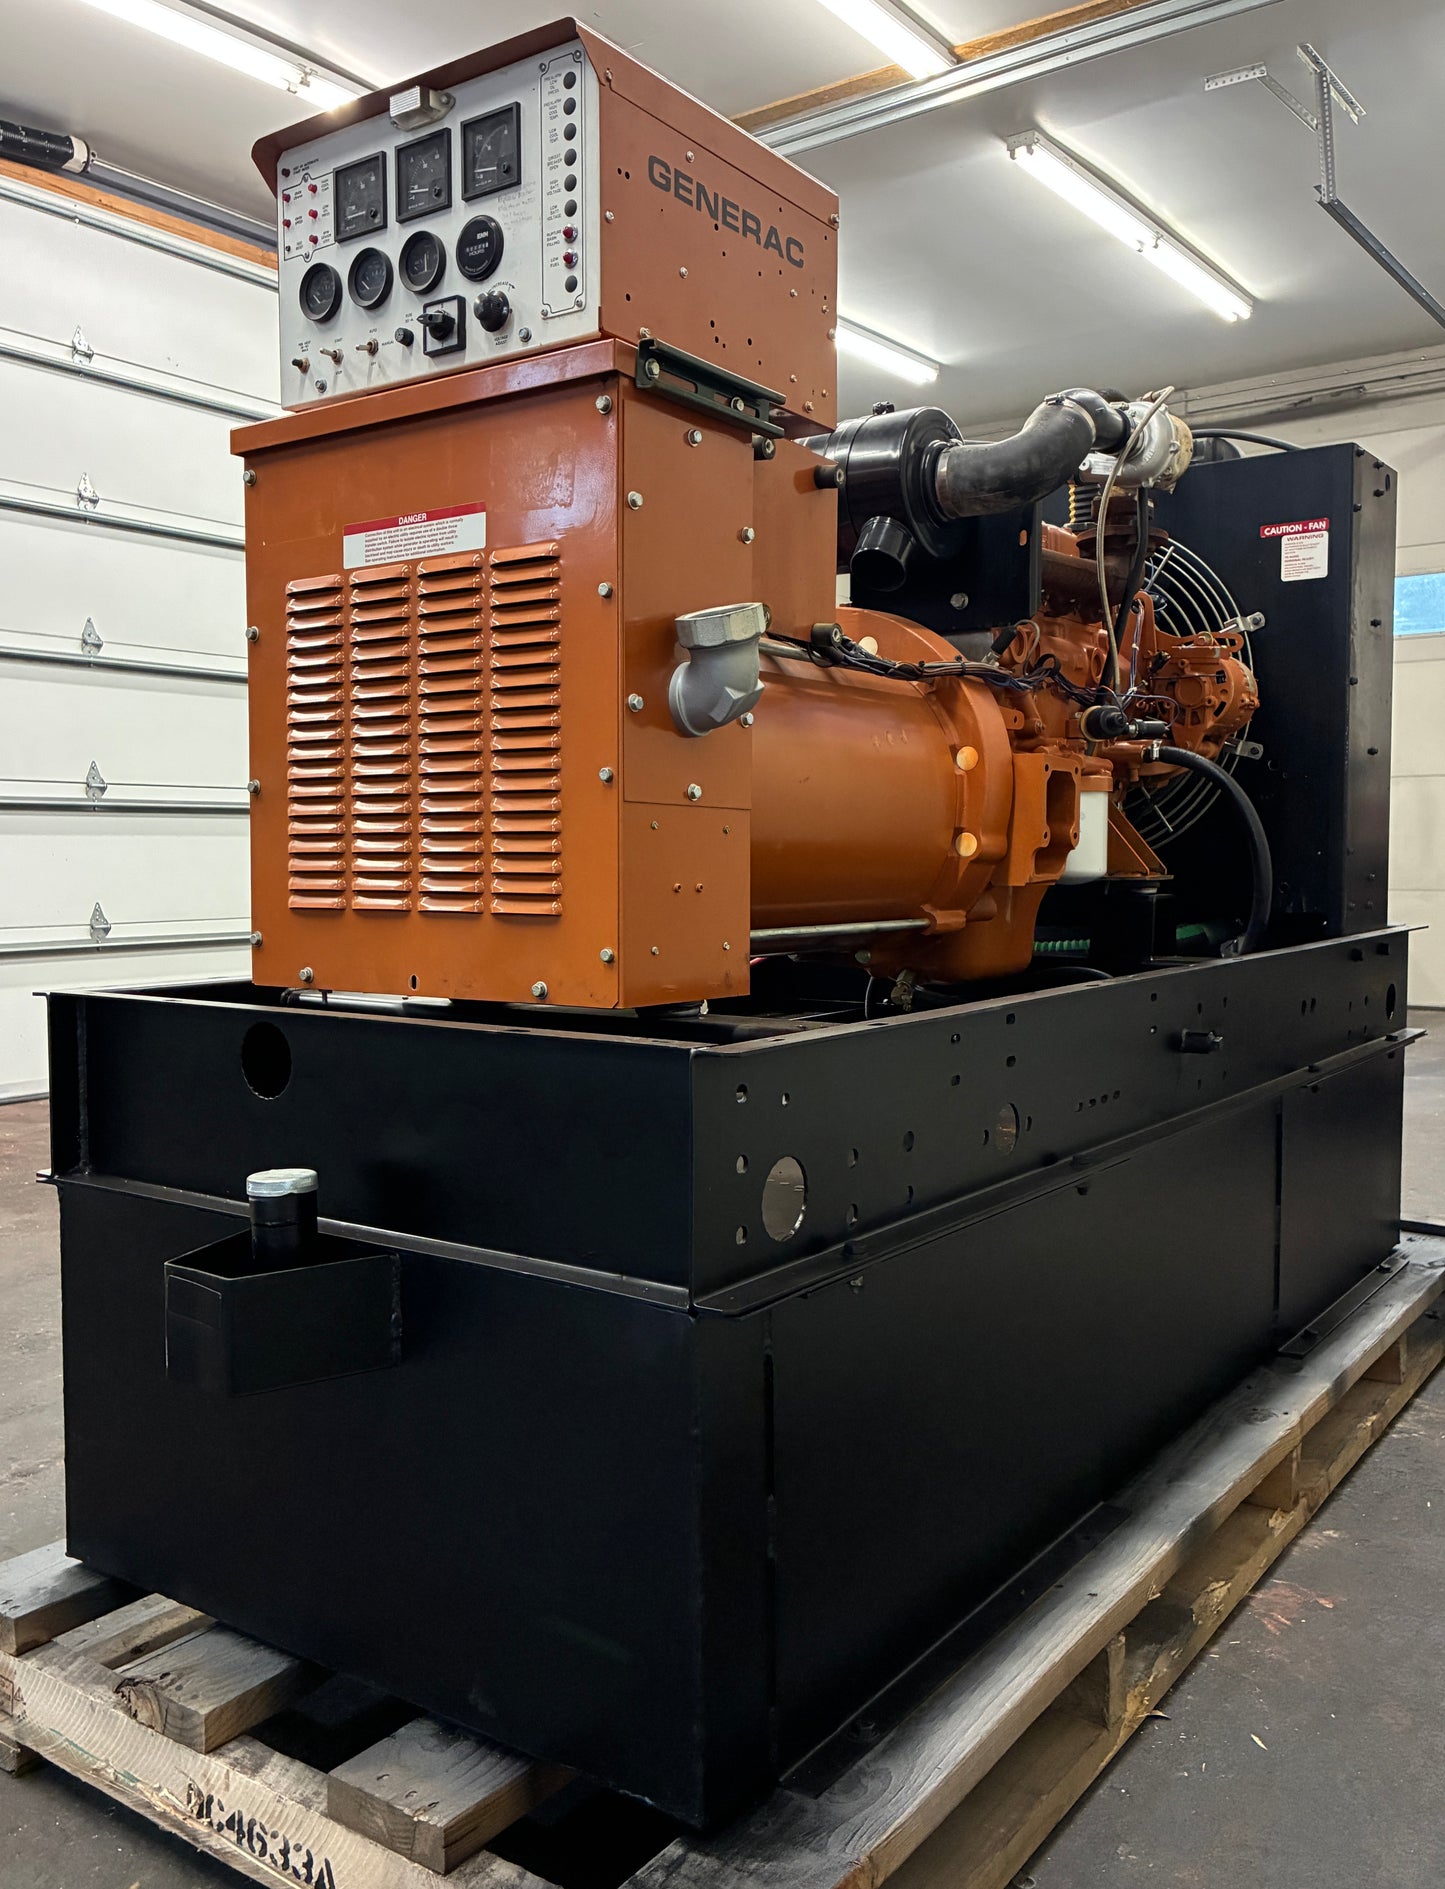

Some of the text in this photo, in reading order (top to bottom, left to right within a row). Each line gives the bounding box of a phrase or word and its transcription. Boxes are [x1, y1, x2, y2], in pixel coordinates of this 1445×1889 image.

[648, 154, 804, 268] GENERAC
[398, 513, 427, 525] DANGER
[1264, 524, 1302, 535] CAUTION
[1308, 521, 1326, 530] FAN
[1287, 533, 1324, 541] WARNING
